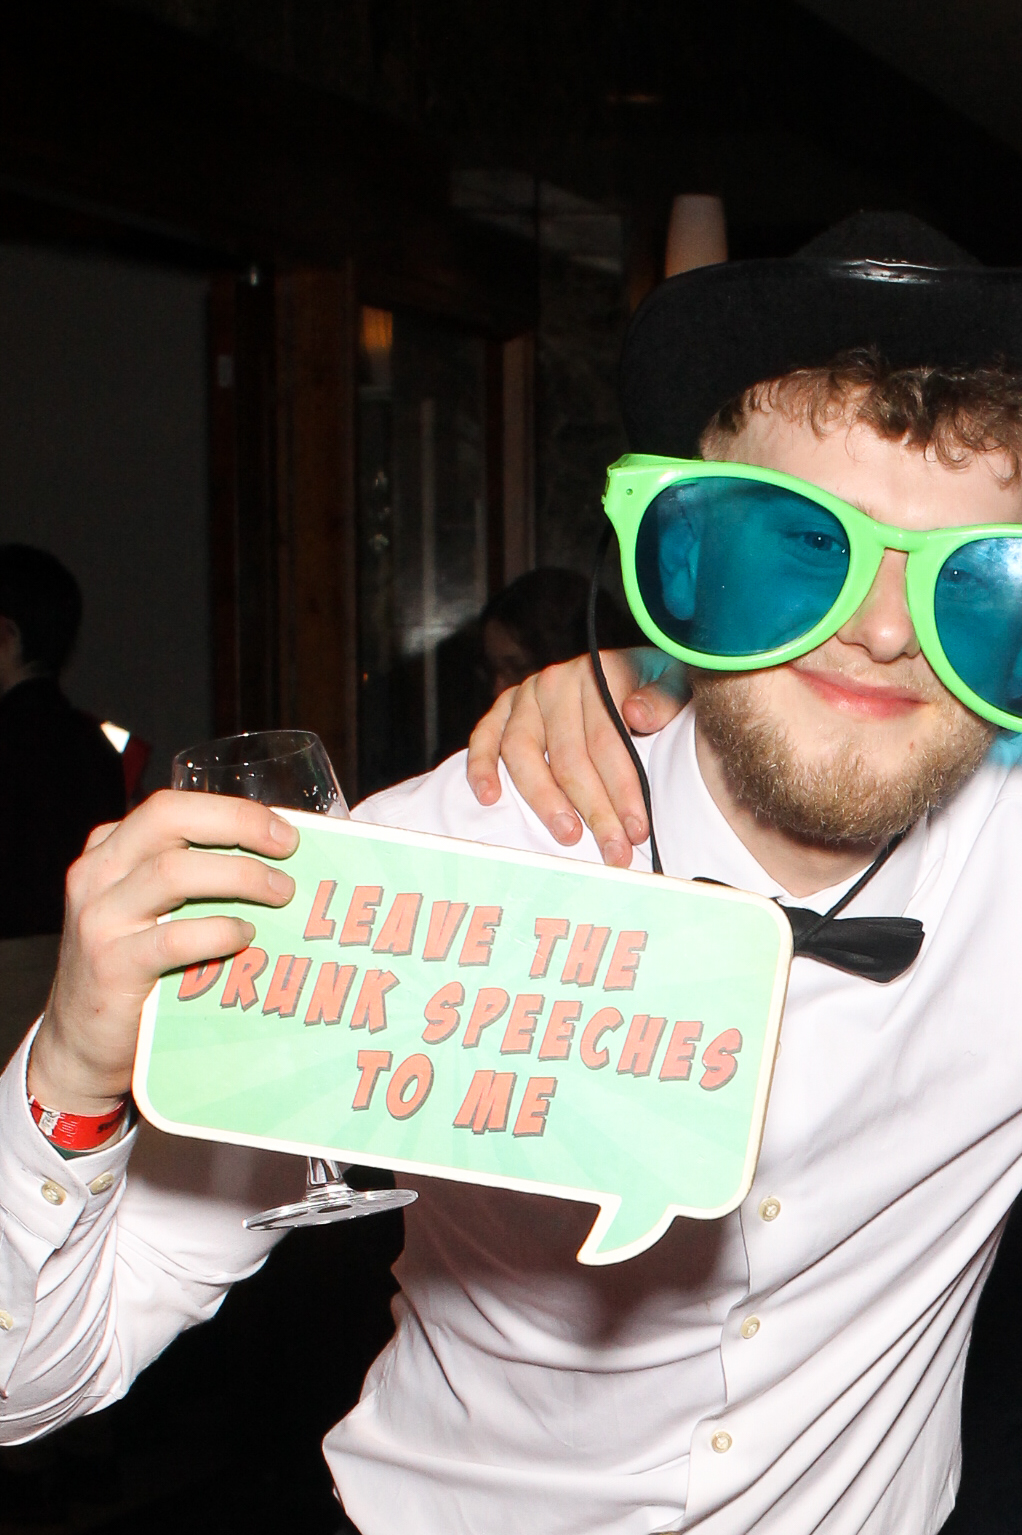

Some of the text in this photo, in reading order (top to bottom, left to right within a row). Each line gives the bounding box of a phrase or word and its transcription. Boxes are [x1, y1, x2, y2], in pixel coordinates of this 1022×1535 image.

[303, 880, 648, 992] LEAVE THE
[177, 946, 743, 1091] DRUNK SPEECHES
[351, 1049, 557, 1138] TO ME
